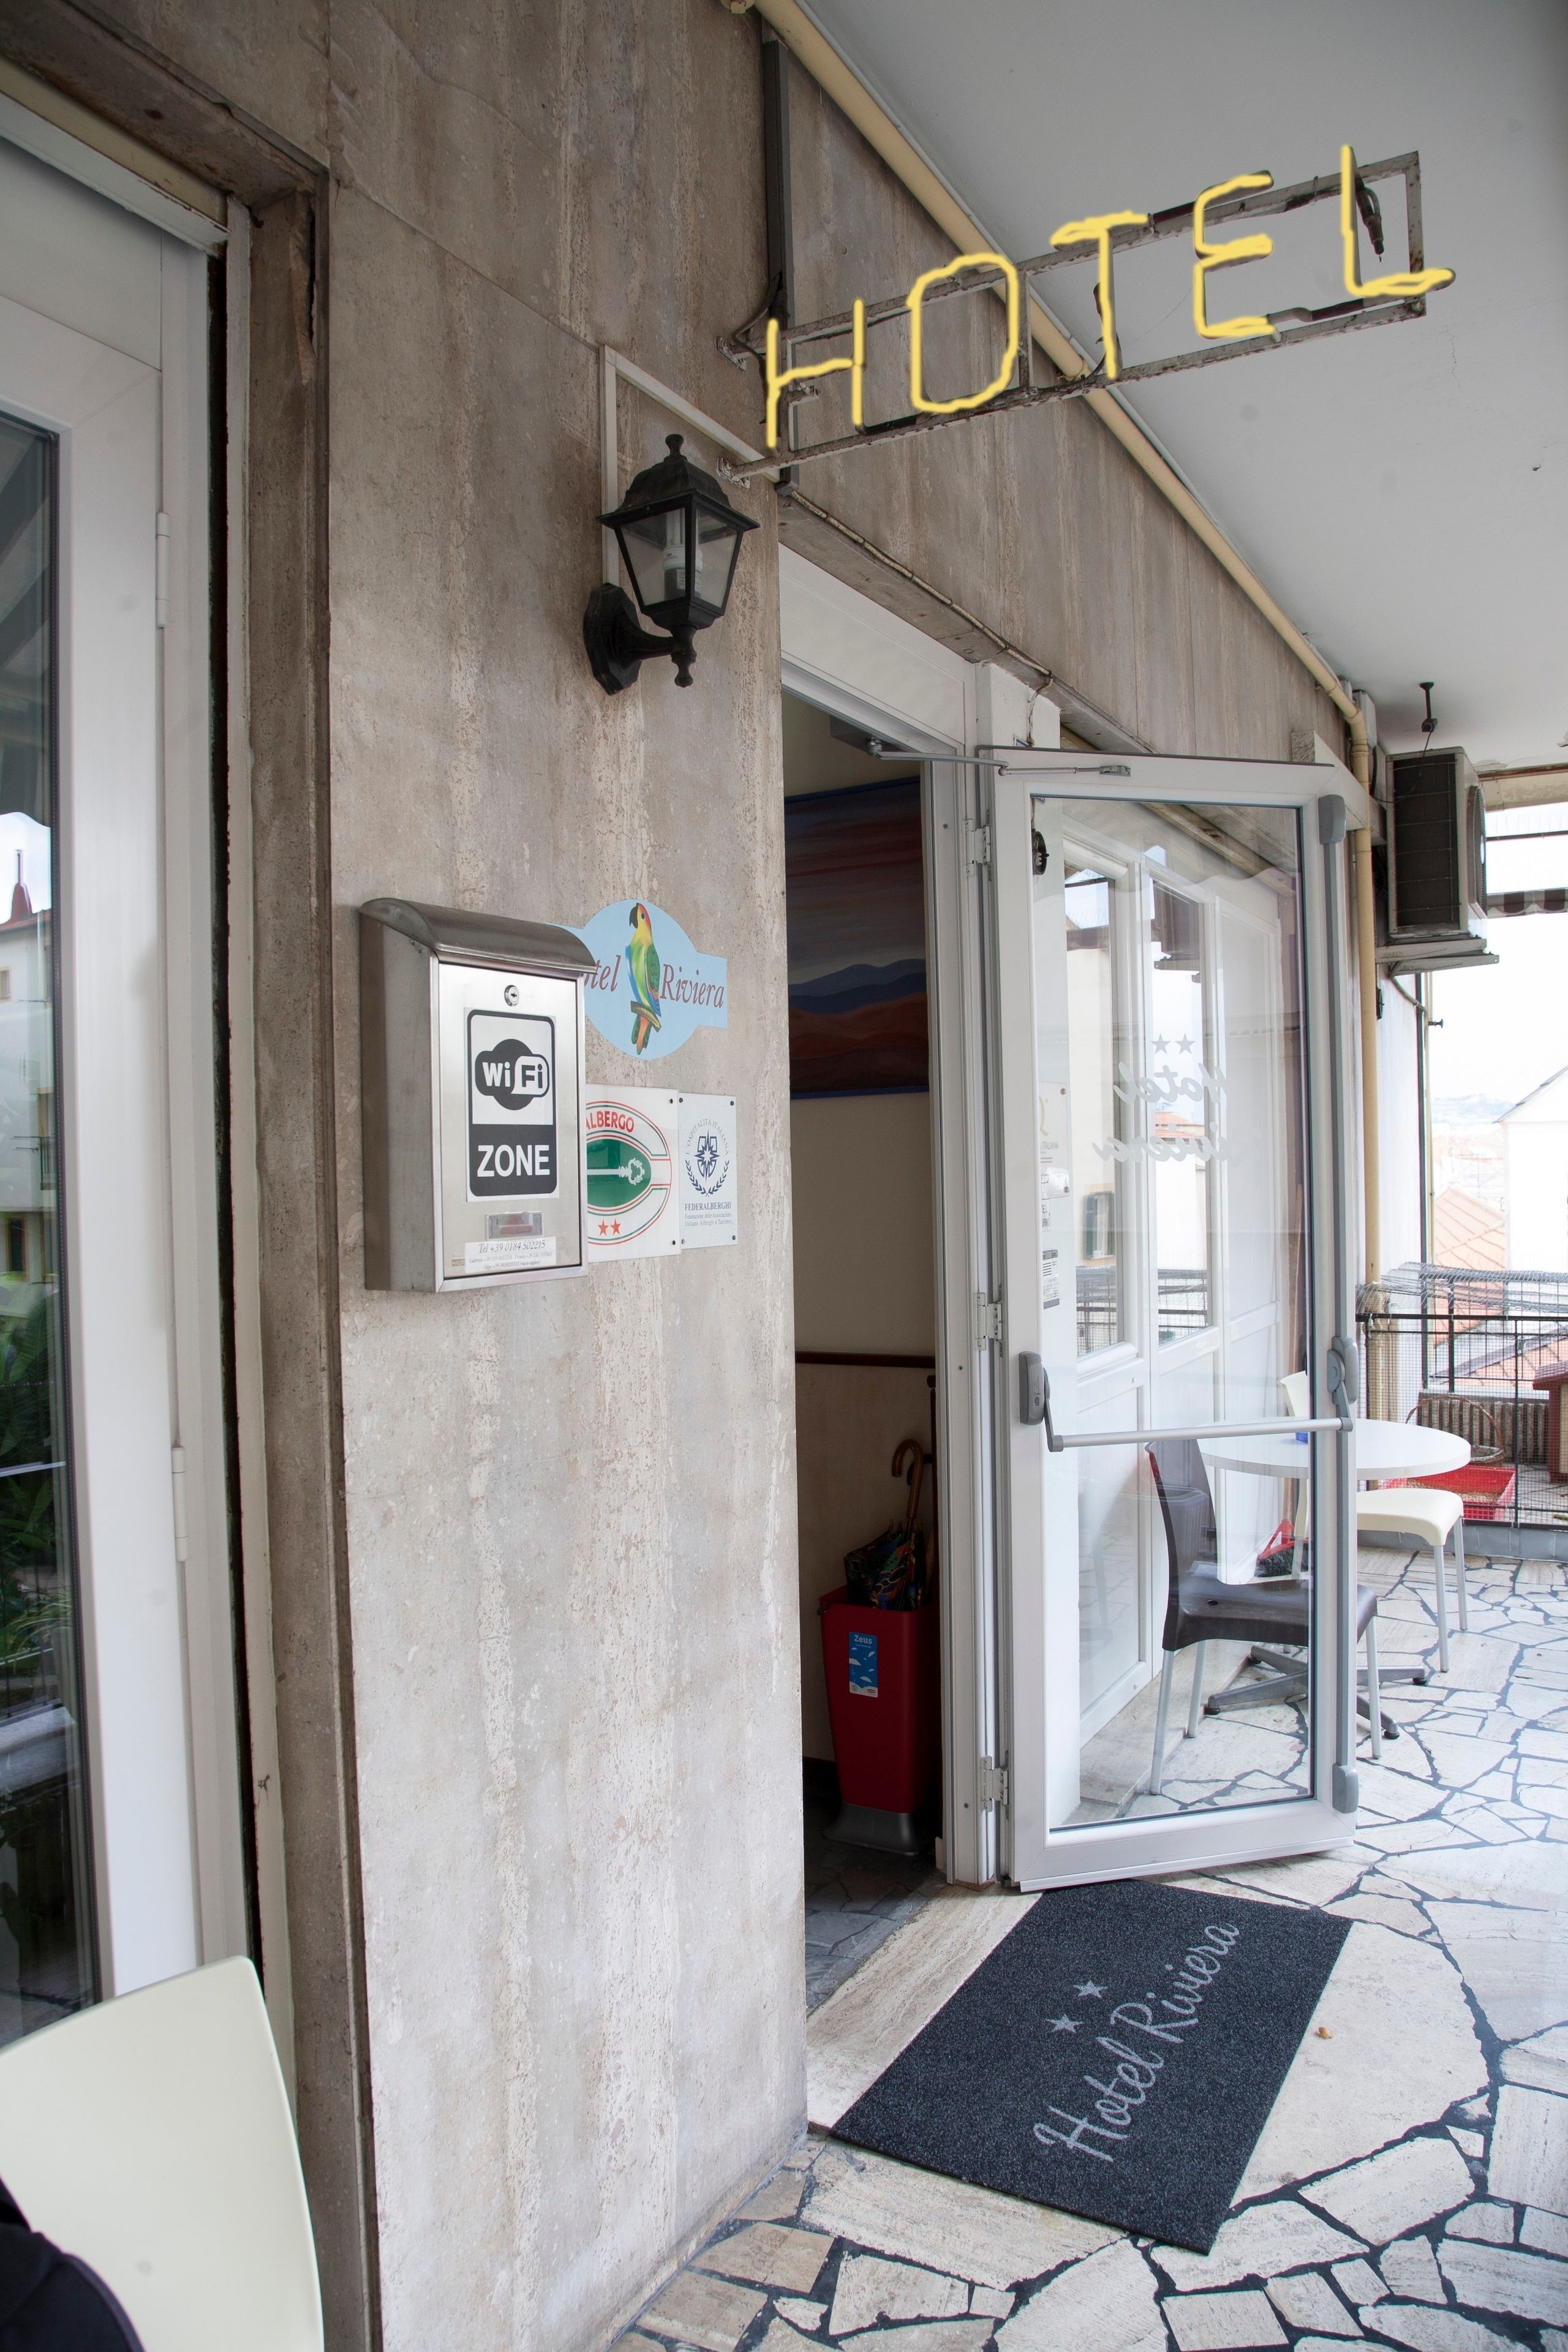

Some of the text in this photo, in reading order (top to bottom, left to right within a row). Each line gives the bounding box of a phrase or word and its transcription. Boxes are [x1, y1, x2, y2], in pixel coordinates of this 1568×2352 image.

[766, 144, 1456, 448] HOTEL
[584, 955, 725, 1009] tel Riviera
[477, 1144, 550, 1177] ZONE
[685, 1201, 731, 1211] FEDERALBERGHI
[490, 1242, 503, 1253] +39
[505, 1241, 521, 1252] 0184
[854, 1634, 873, 1645] Zeus
[1032, 1922, 1240, 2163] Hotel Riviera
